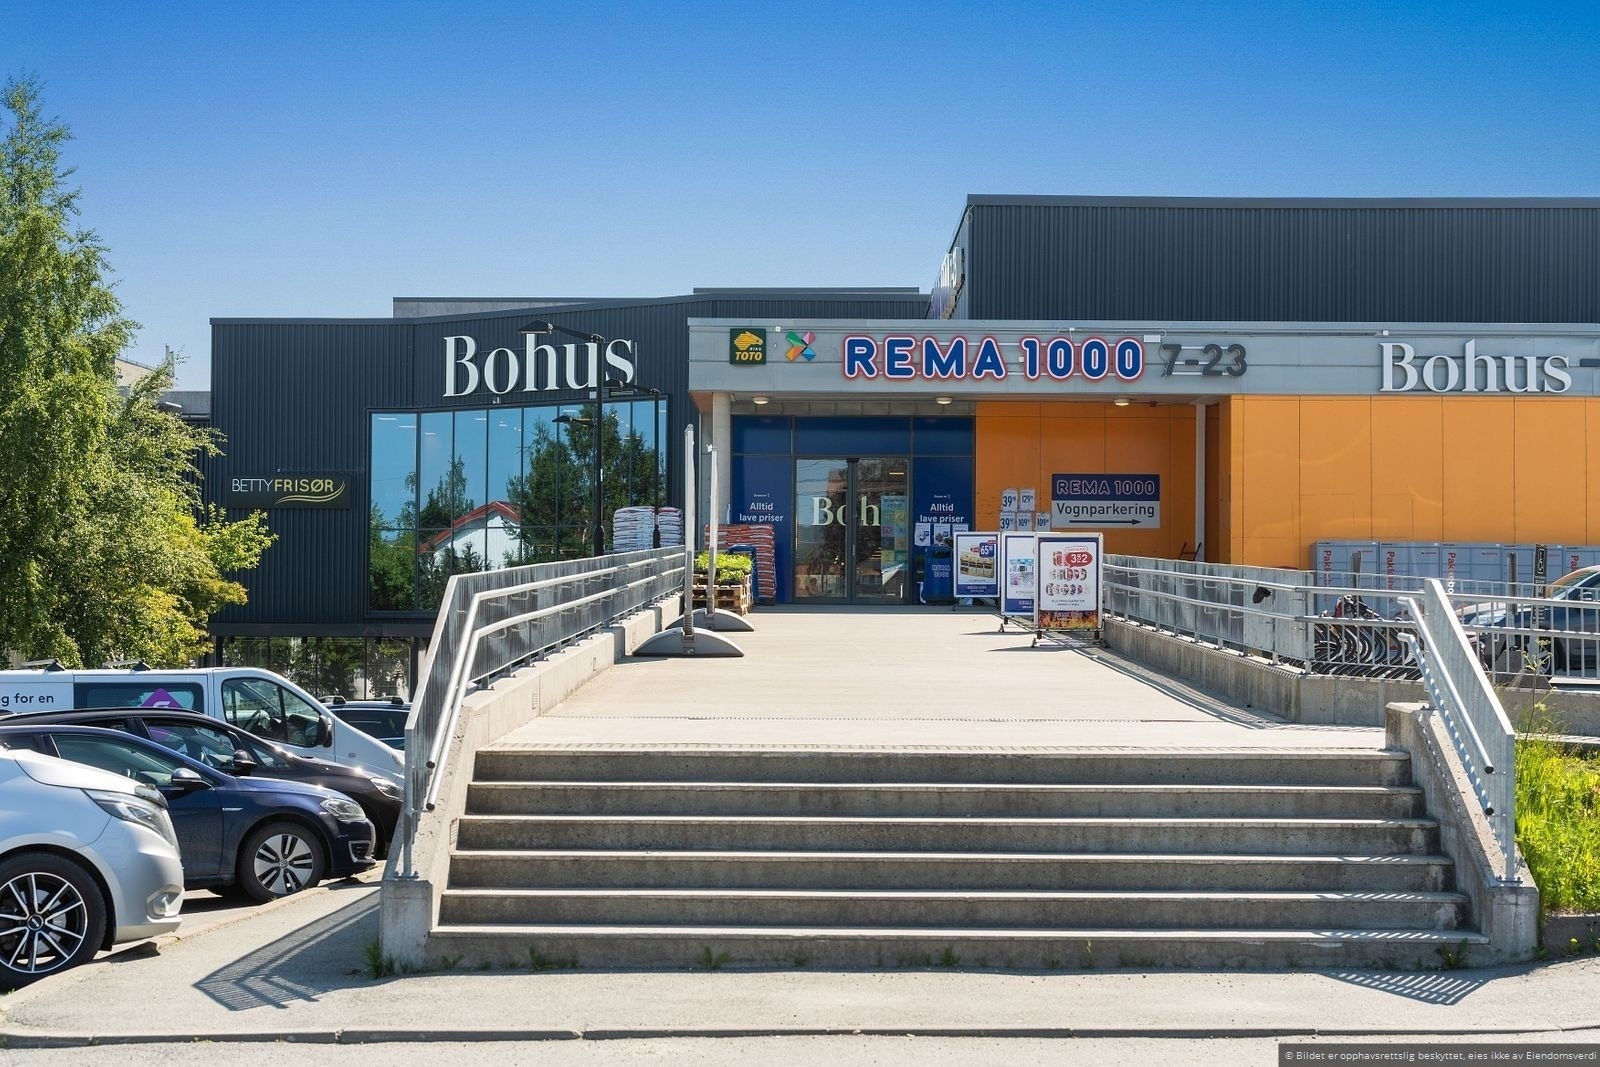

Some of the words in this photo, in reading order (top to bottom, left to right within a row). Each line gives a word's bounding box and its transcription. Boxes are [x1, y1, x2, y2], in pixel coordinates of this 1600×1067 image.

[735, 351, 763, 361] TOTO
[843, 336, 1008, 380] REMA
[1019, 336, 1145, 380] 1000
[1161, 344, 1247, 377] 7-23
[443, 333, 634, 397] Bohus
[1379, 338, 1573, 393] Bohus
[1056, 480, 1111, 495] REMA
[1114, 480, 1155, 495] 1000
[749, 502, 774, 511] Alltid
[930, 503, 954, 511] Alltid
[1056, 503, 1155, 518] Vognparkering
[739, 513, 757, 522] lave
[758, 513, 784, 523] priser
[919, 514, 938, 523] lave
[939, 514, 965, 524] priser
[14, 693, 33, 704] for
[38, 695, 54, 704] en
